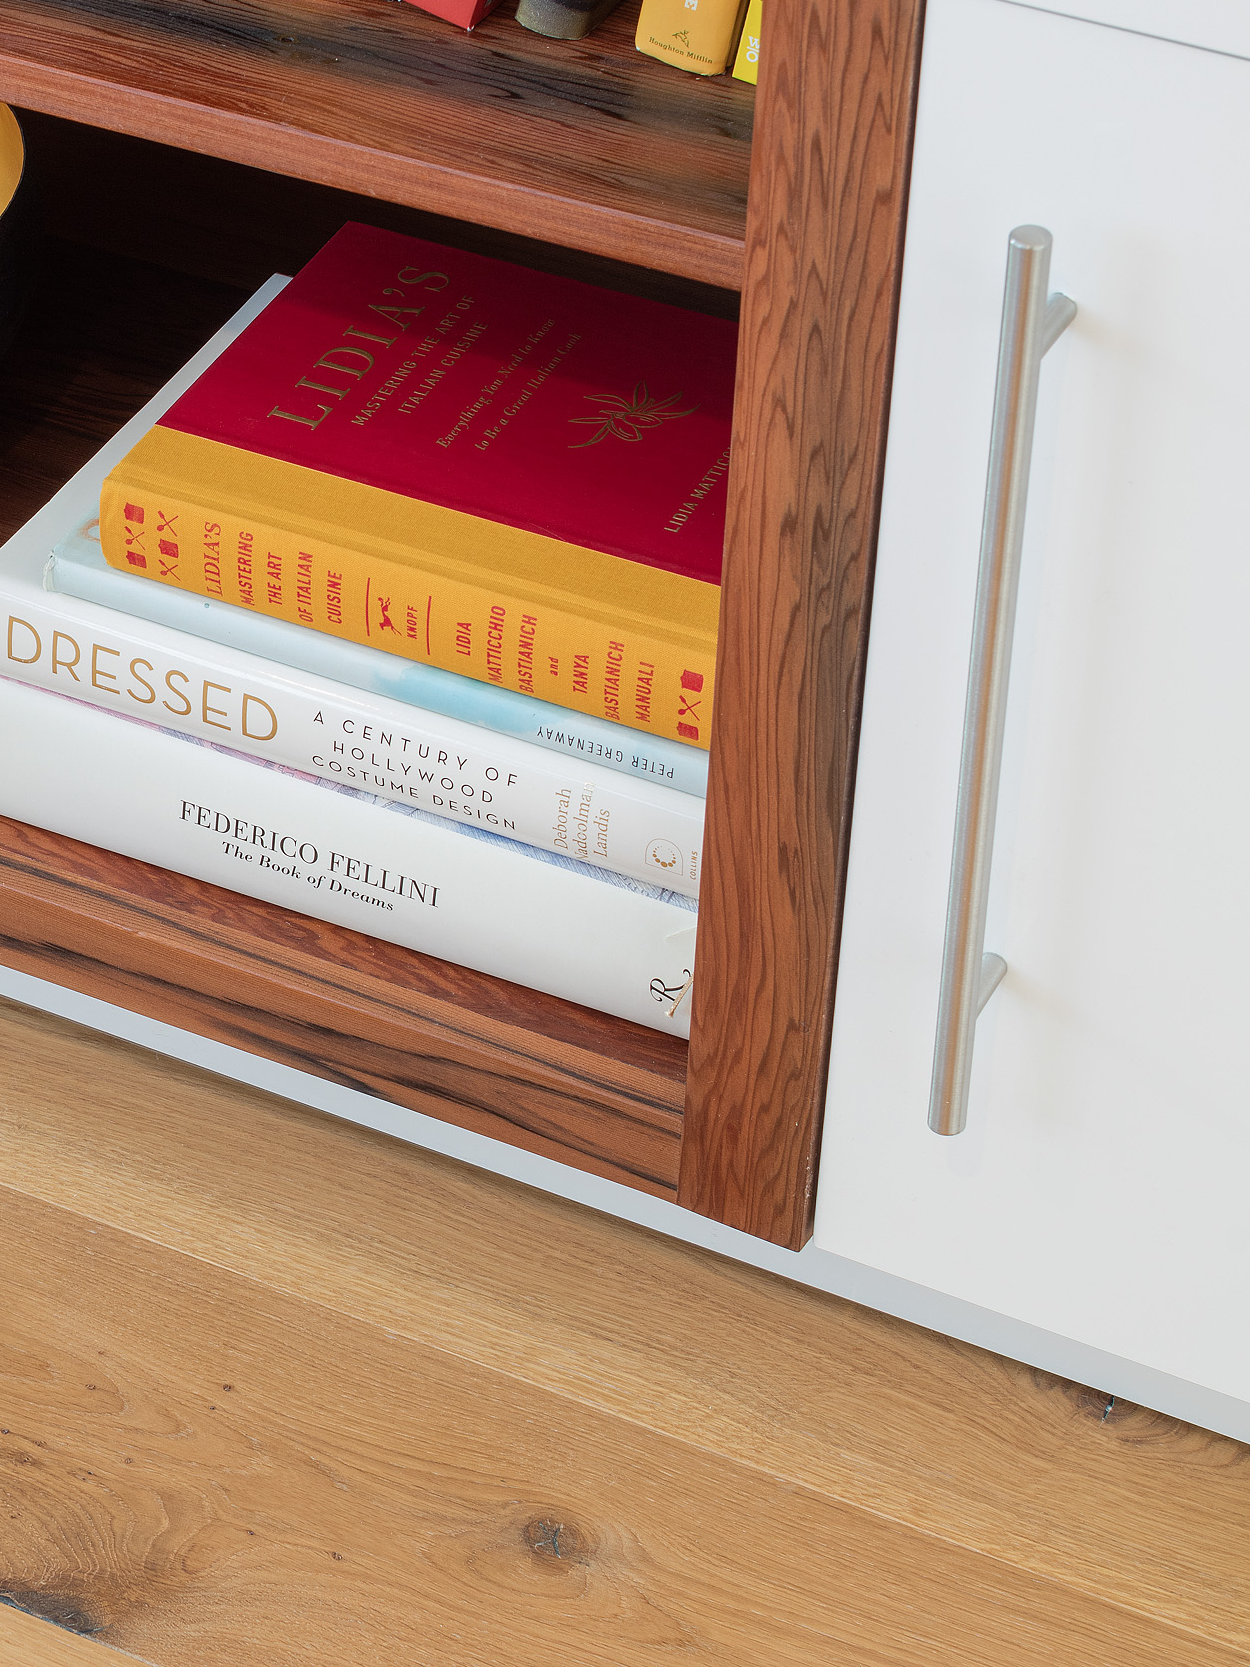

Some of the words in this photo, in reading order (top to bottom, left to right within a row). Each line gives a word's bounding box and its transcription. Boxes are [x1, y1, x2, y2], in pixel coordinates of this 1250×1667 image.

[649, 37, 684, 55] Houghton
[687, 51, 712, 64] Mifflin
[267, 266, 450, 430] LIDIA'S
[352, 360, 417, 425] MASTERING
[412, 336, 440, 357] THE
[435, 312, 459, 334] ART
[457, 295, 475, 309] OF
[398, 369, 446, 414] ITALIAN
[441, 322, 488, 366] CUISINE
[436, 396, 492, 448] Everything
[482, 379, 503, 396] You
[498, 354, 523, 378] Need
[519, 345, 532, 355] to
[527, 319, 555, 344] Know
[475, 440, 489, 451] to
[484, 426, 501, 439] Be
[504, 389, 532, 416] Great
[527, 356, 562, 389] Italian
[664, 503, 698, 532] LIDIA
[203, 522, 223, 597] LIDIA'S
[238, 531, 255, 606] MASTERING
[268, 552, 282, 575] ART
[297, 552, 313, 606] ITALIAN
[269, 580, 282, 605] THE
[298, 608, 313, 622] OF
[327, 571, 342, 624] CUISINE
[407, 605, 417, 639] KNOPF
[456, 622, 472, 656] LIDIA
[487, 606, 506, 683] MATTICCHIO
[517, 614, 537, 693] BASTIANICH
[548, 657, 558, 676] and
[8, 615, 278, 741] DRESSED
[573, 654, 589, 694] TANYA
[604, 641, 625, 720] BASTIANICH
[636, 662, 655, 722] MANUALI
[314, 711, 324, 724] A
[342, 720, 467, 770] CENTURY
[485, 767, 517, 786] OF
[334, 741, 493, 802] HOLLYWOOD
[537, 726, 623, 762] GREENAWAY
[631, 756, 674, 779] PETER
[312, 755, 418, 798] COSTUME
[433, 795, 516, 830] DESIGN
[553, 789, 571, 850] Deborah
[179, 800, 318, 865] FEDERICO
[327, 851, 441, 908] FELLINI
[593, 809, 610, 857] Landis
[222, 841, 253, 863] The
[259, 854, 301, 879] Book
[307, 875, 326, 888] of
[329, 879, 394, 911] Dreams
[690, 851, 698, 880] COLLINS
